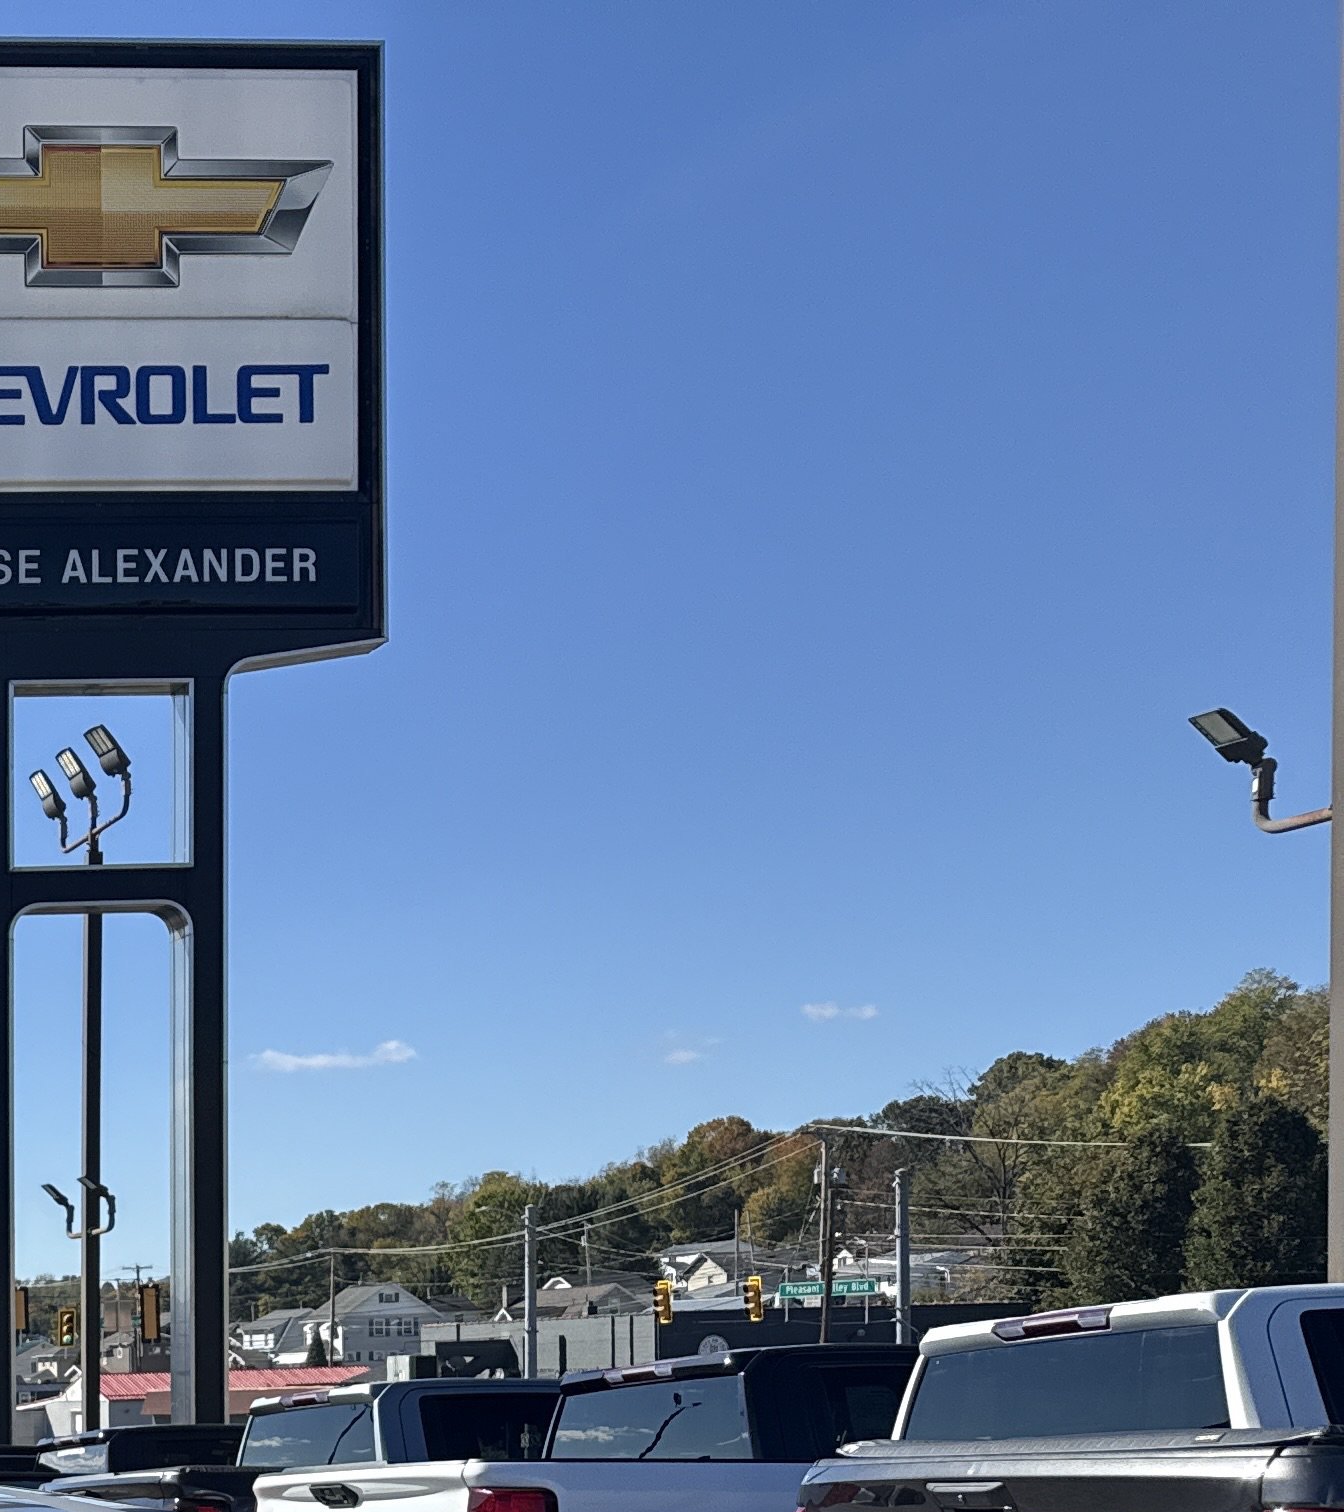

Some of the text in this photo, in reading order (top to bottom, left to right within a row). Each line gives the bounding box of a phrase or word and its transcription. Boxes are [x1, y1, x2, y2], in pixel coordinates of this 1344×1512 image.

[61, 546, 318, 584] ALEXANDER
[785, 1284, 820, 1295] Pleasant
[851, 1281, 869, 1292] Blvd
